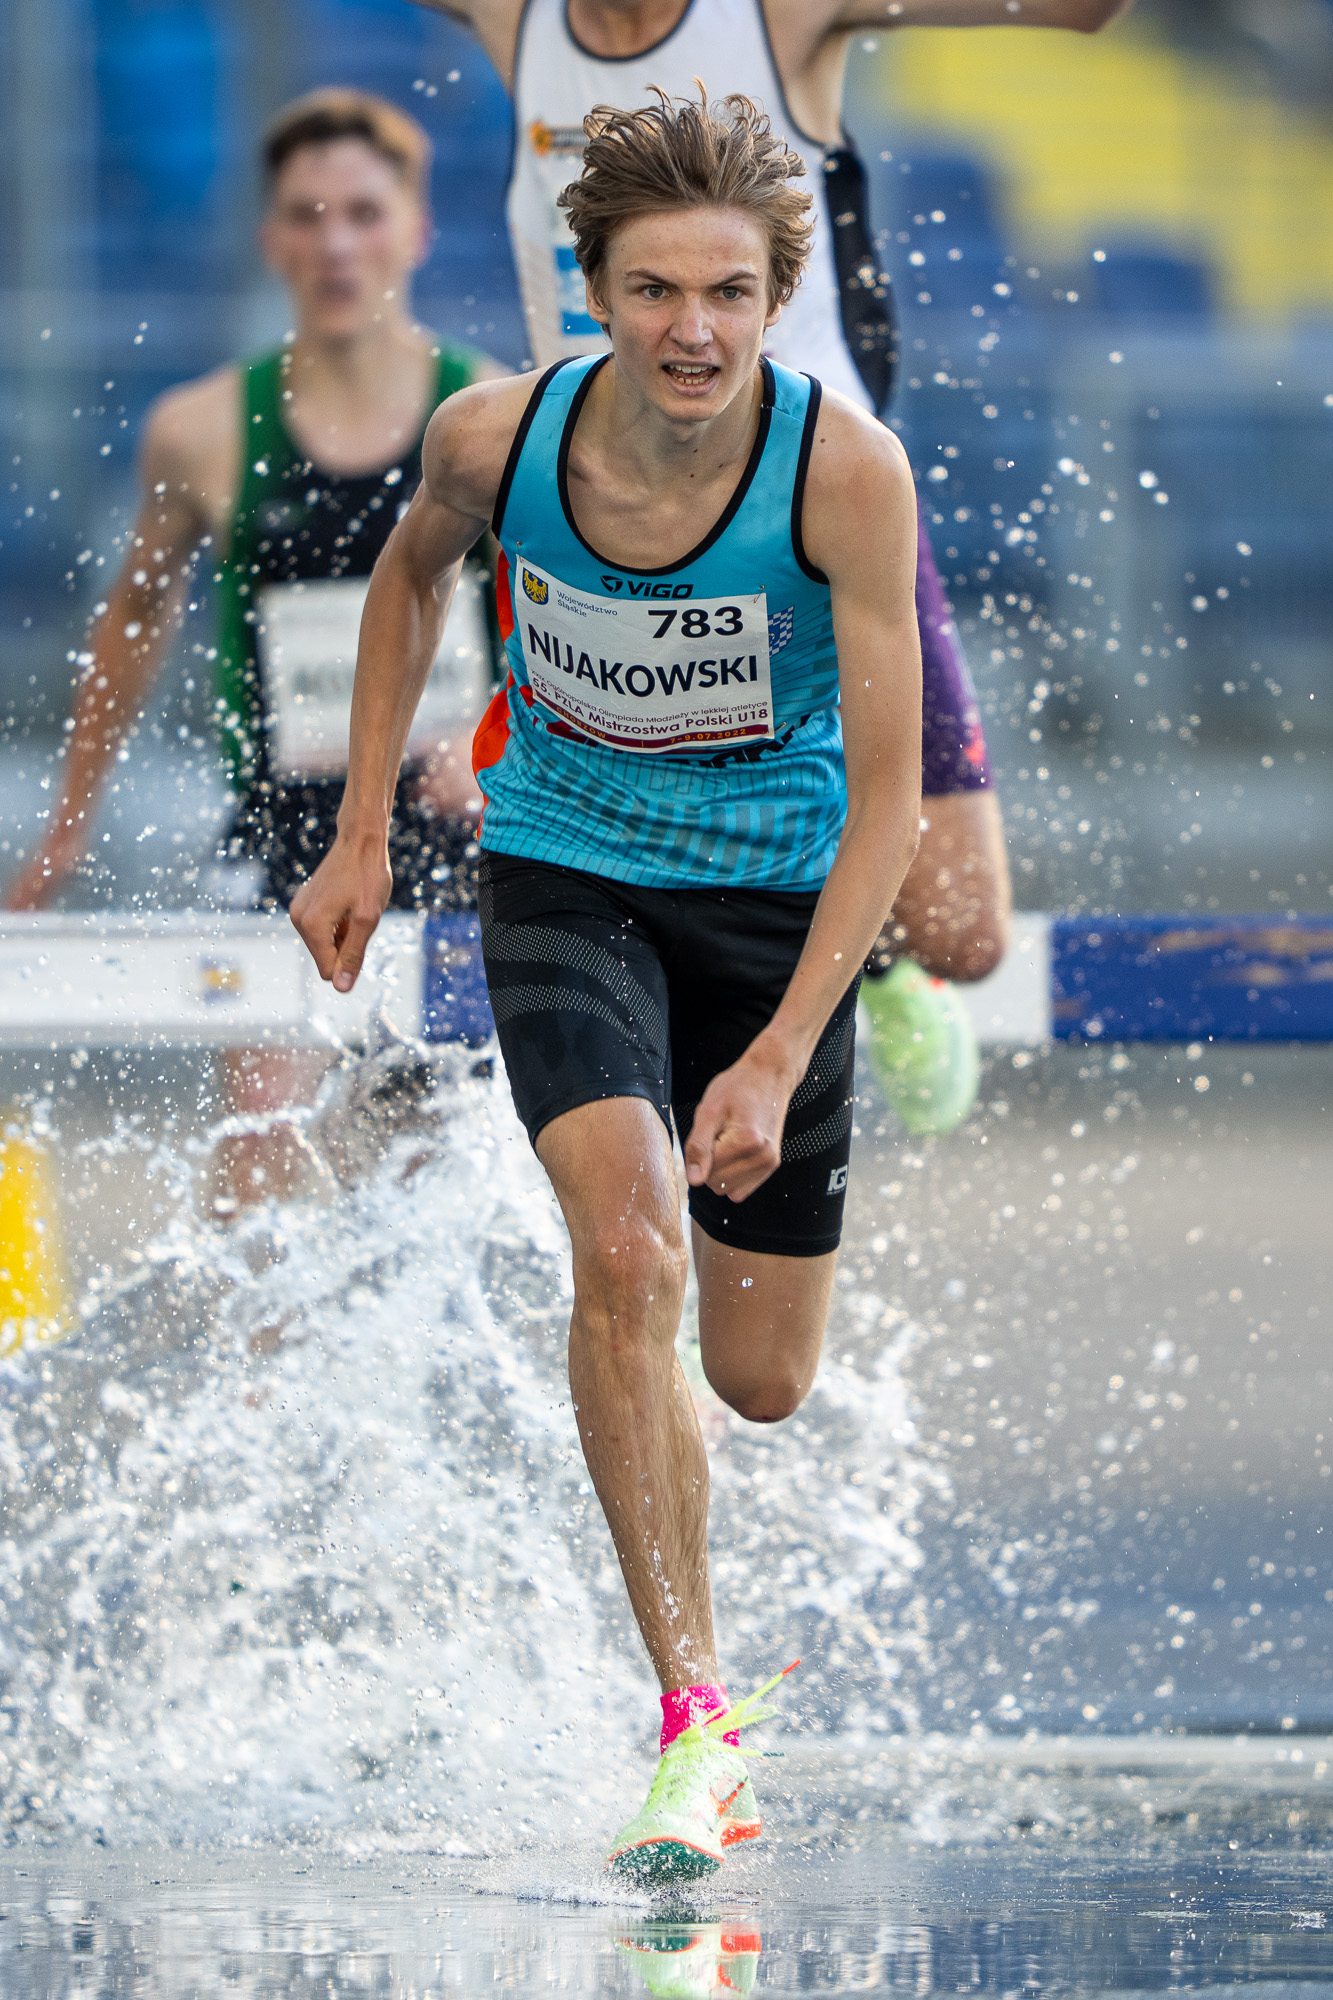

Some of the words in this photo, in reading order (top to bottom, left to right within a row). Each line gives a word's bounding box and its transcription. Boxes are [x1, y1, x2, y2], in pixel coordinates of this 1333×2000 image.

[556, 590, 618, 616] Województwo
[557, 599, 588, 617] Śląskie
[647, 605, 744, 639] 783
[528, 622, 758, 697] NIJAKOWSKI
[532, 677, 551, 696] 55.
[555, 691, 585, 717] PZLA
[588, 711, 680, 735] Mistrzostwa
[685, 714, 733, 728] Polski
[738, 708, 769, 722] U18
[598, 707, 644, 723] Olimpiada
[646, 711, 690, 723] Młodzieży
[701, 706, 729, 716] lekkiej
[731, 701, 768, 712] atletyce
[669, 728, 747, 744] 7-9.07.2022
